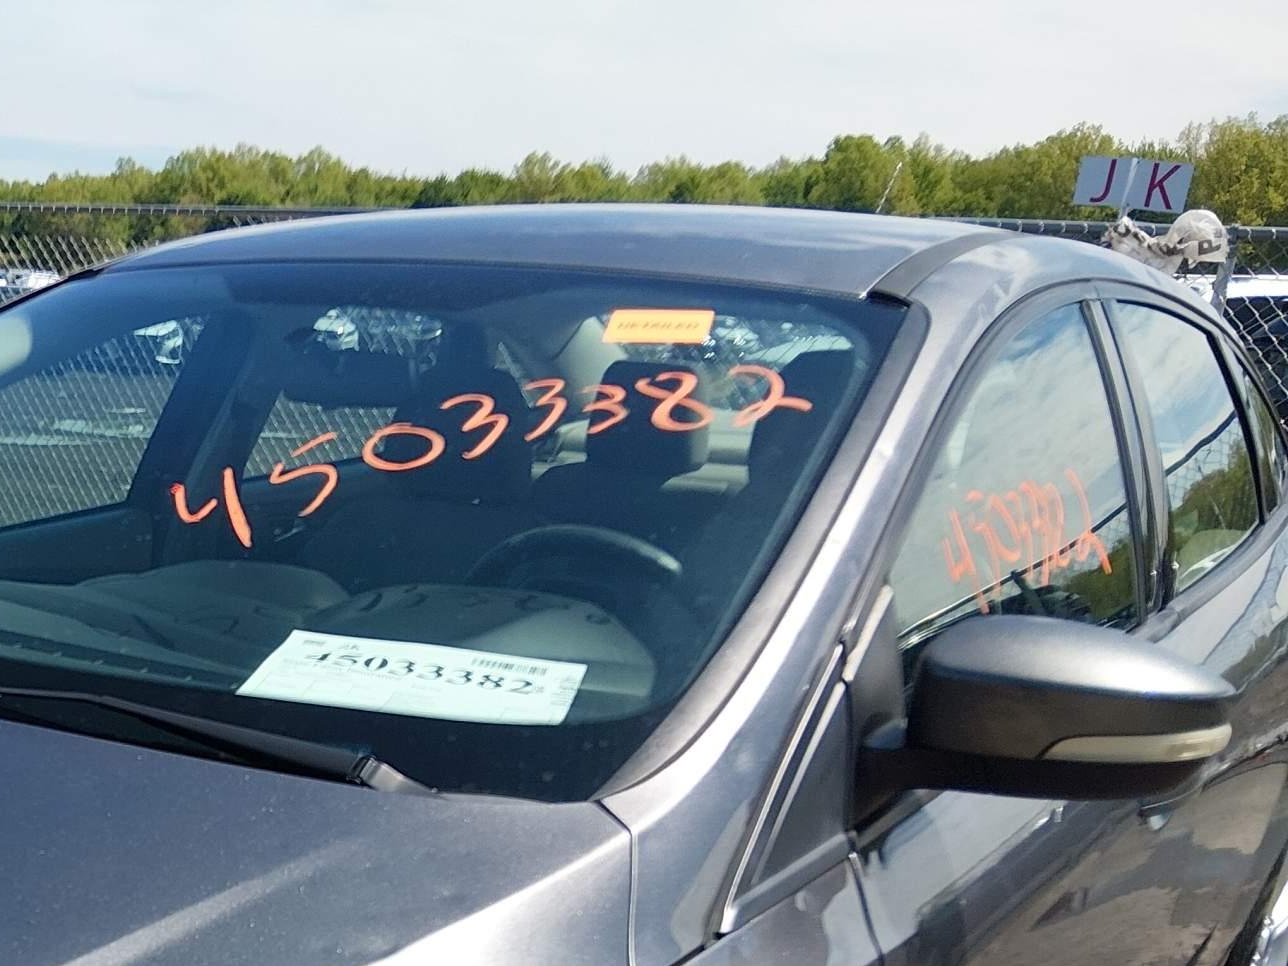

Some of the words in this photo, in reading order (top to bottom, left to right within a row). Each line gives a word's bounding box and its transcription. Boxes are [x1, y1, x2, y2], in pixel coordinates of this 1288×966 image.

[1089, 159, 1117, 203] J
[1144, 162, 1182, 210] K
[170, 365, 813, 548] 45033382
[304, 652, 533, 695] 45033382
